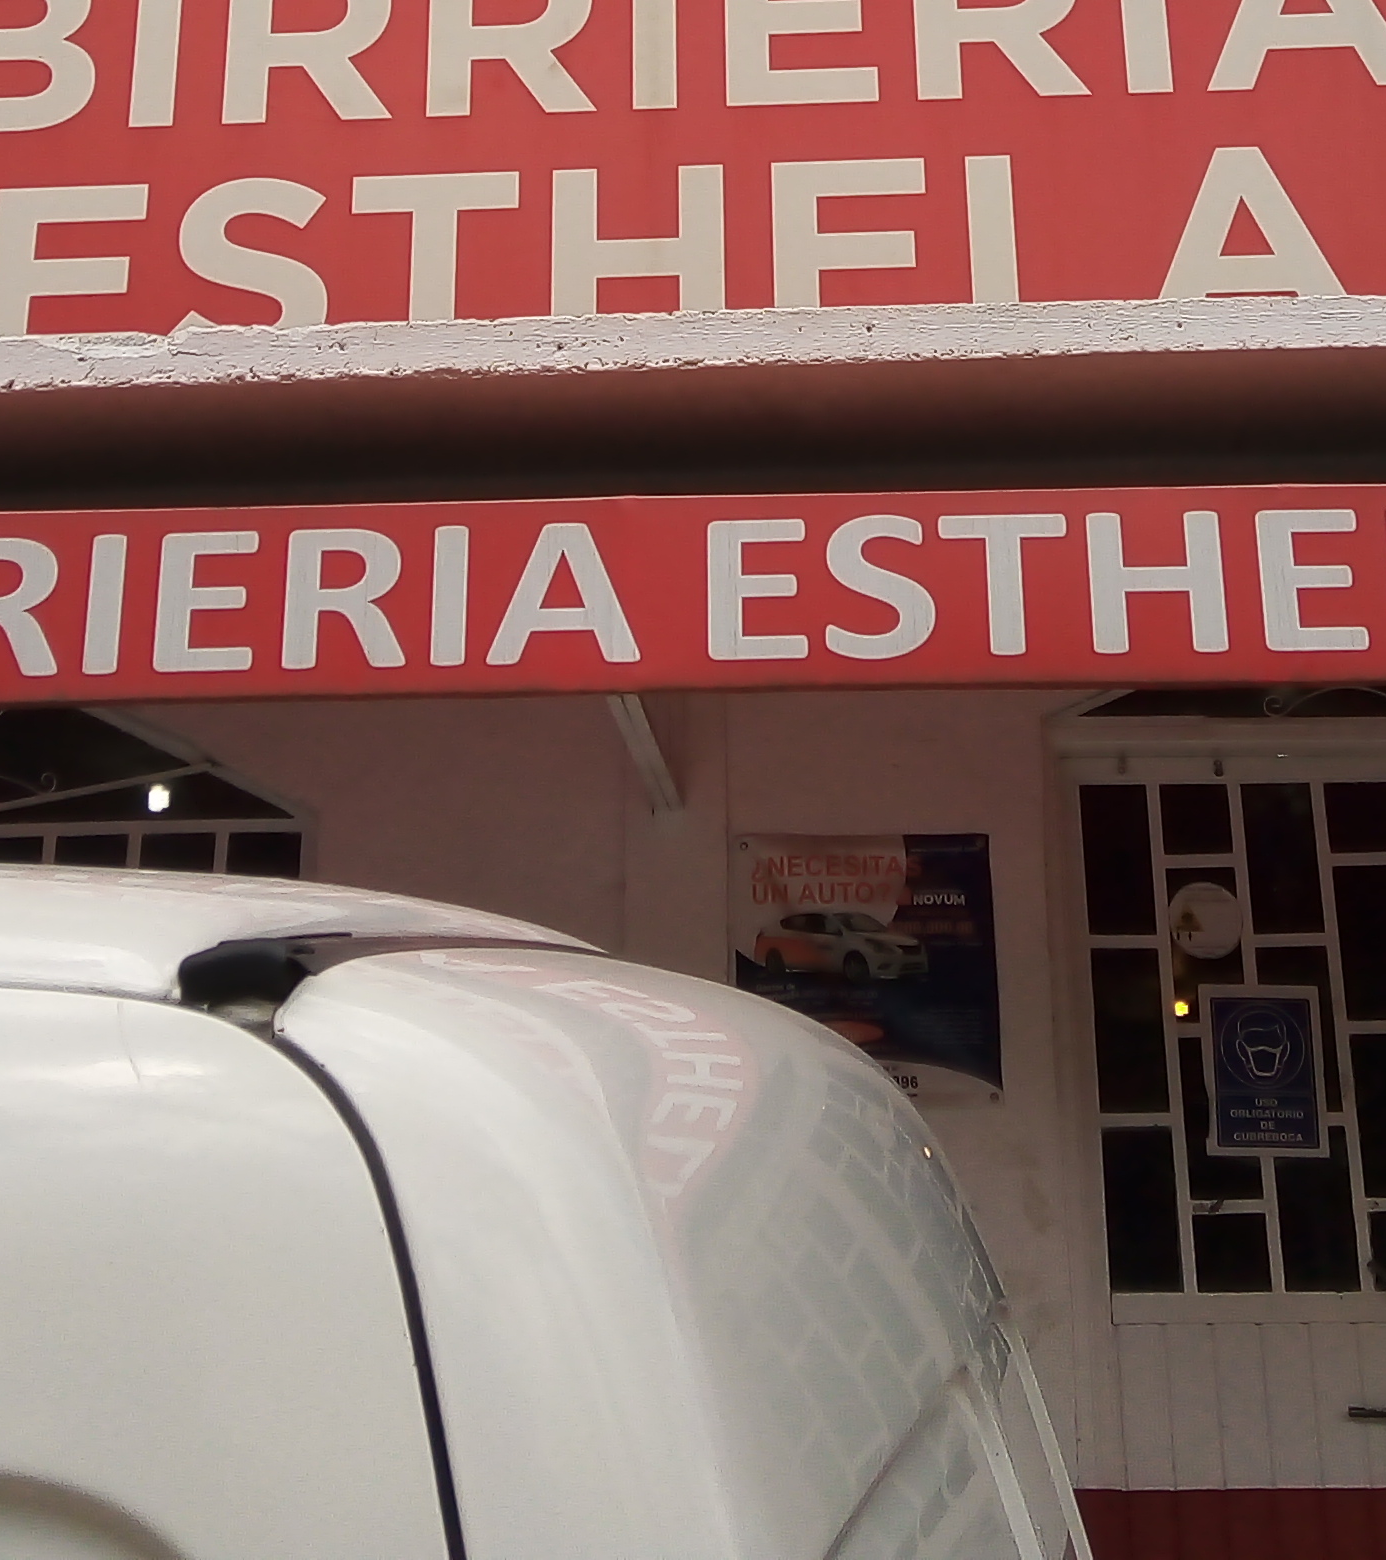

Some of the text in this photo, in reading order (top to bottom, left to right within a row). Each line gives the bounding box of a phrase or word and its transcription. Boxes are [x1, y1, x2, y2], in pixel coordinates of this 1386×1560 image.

[751, 854, 922, 881] ¿NECESITAS
[752, 883, 789, 906] UN
[913, 893, 967, 907] NOVUM
[1254, 1098, 1279, 1107] USO
[1230, 1108, 1305, 1119] OBLIGATORIO
[1260, 1121, 1276, 1130] DE
